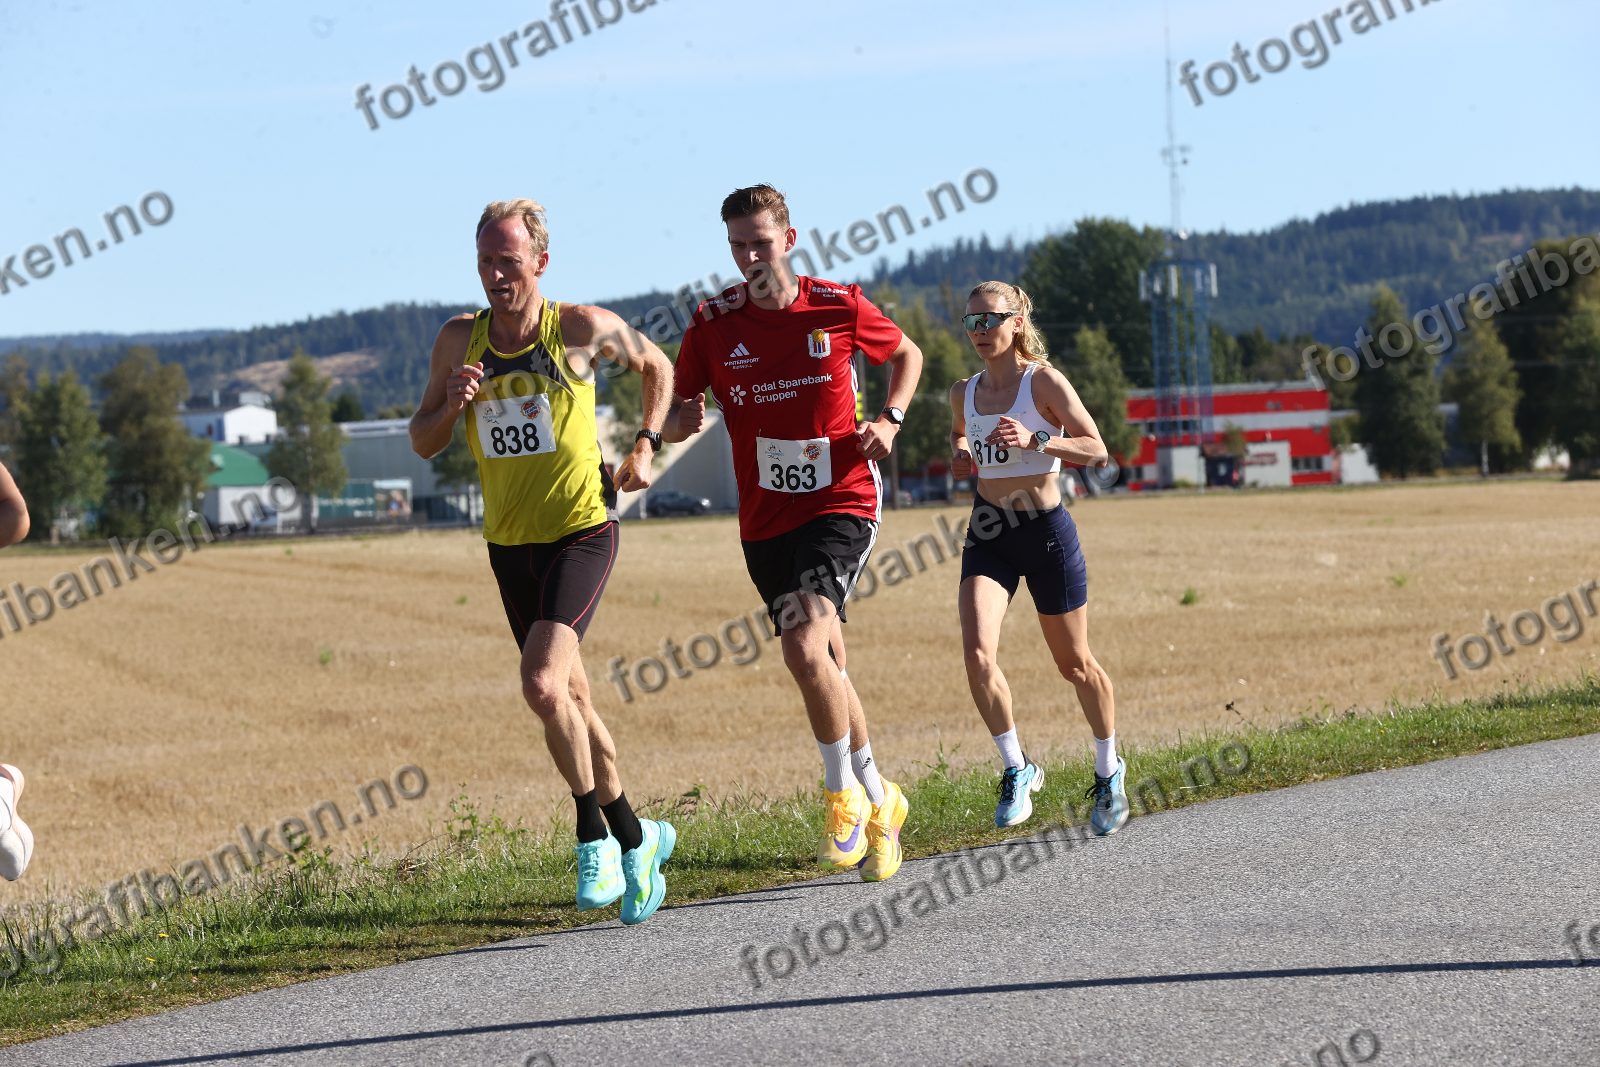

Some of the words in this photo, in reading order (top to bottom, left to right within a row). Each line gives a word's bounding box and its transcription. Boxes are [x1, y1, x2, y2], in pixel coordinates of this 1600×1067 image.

[752, 381, 777, 393] Odal
[778, 373, 833, 389] Sparebank
[754, 390, 798, 404] Gruppen
[491, 422, 540, 455] 838
[770, 463, 817, 490] 363
